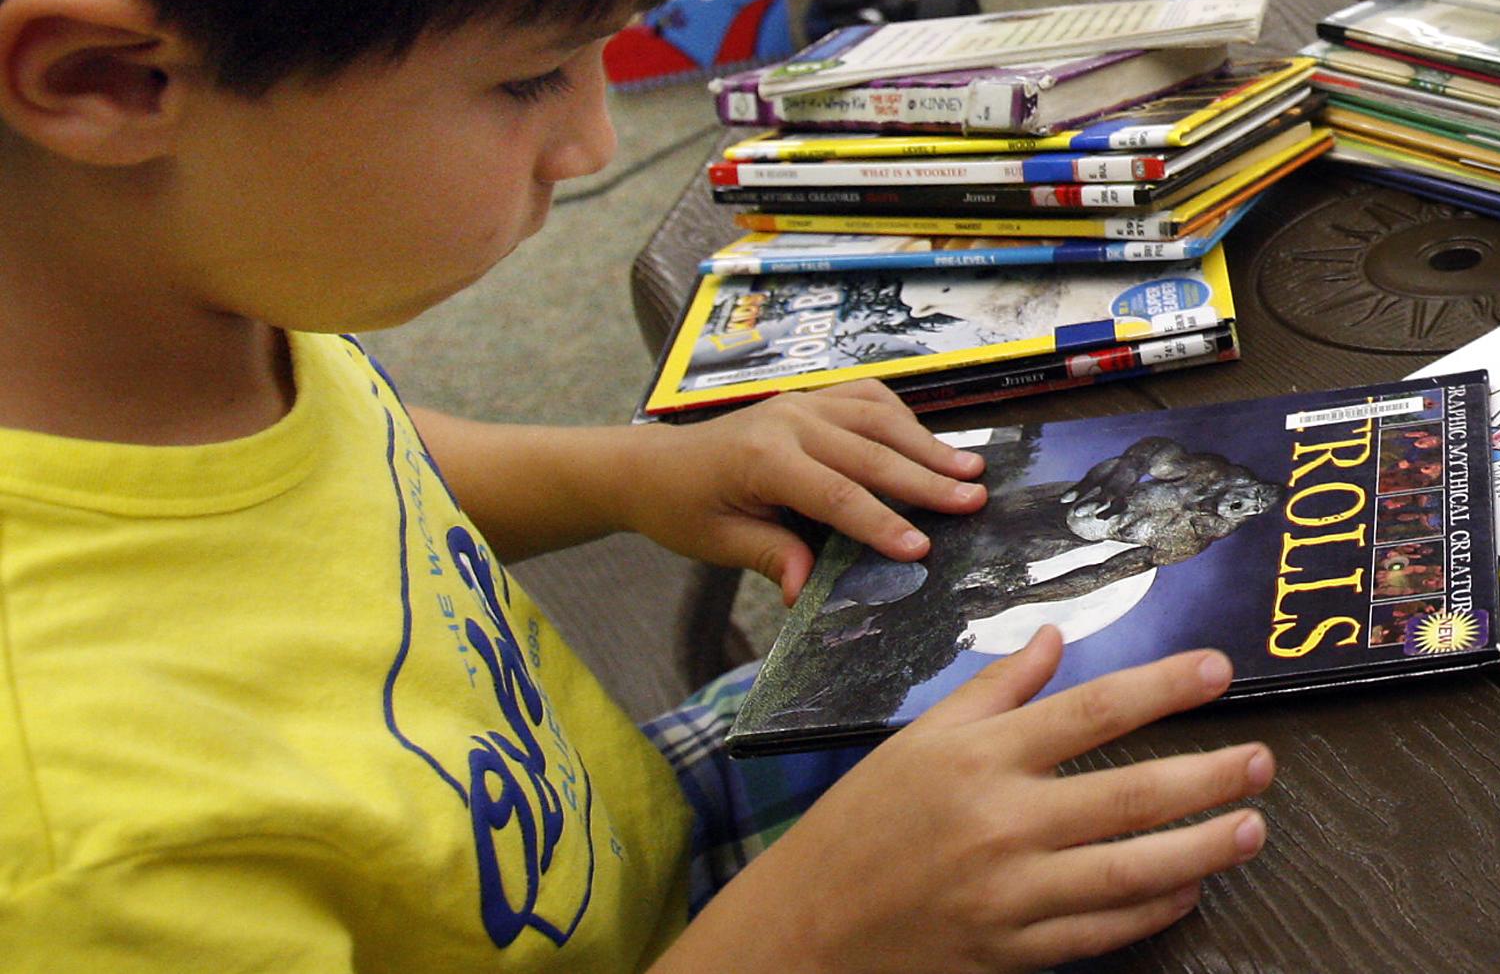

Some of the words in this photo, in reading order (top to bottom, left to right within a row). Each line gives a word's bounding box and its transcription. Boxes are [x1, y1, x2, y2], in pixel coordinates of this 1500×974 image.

[919, 93, 964, 111] KINNEY
[860, 168, 889, 177] WHAT
[1161, 281, 1180, 316] EADER
[1448, 442, 1470, 526] MYTHICAL
[1449, 529, 1473, 614] CREATUR
[436, 593, 477, 689] THE
